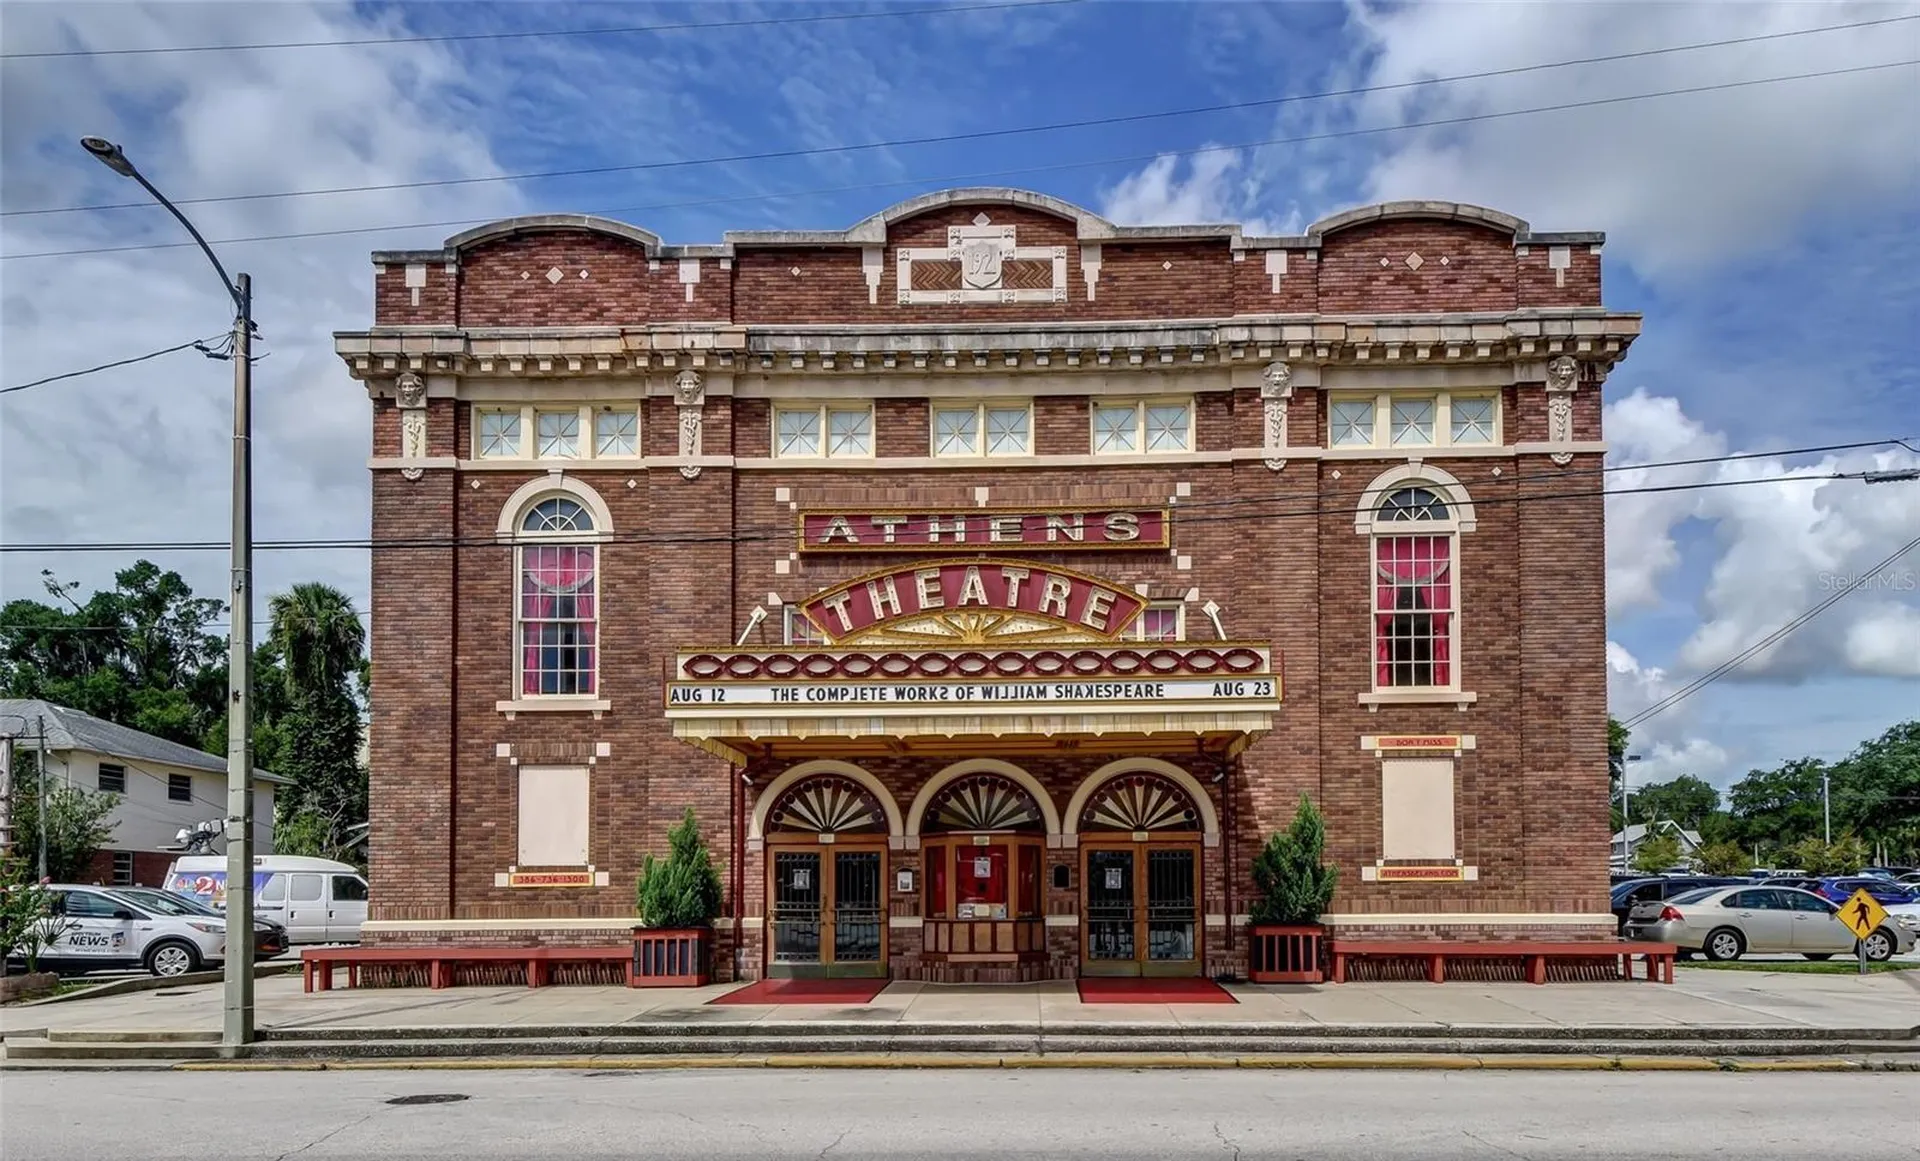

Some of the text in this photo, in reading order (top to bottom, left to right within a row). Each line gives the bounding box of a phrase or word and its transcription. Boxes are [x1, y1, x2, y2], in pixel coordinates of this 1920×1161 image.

[819, 512, 1140, 543] ATHENS
[823, 565, 1118, 632] THEATRE
[671, 681, 1272, 702] AUG 12 THE COMPLETE WORKS OF WILLIAM SHAKESPEARE AUG 23
[68, 936, 109, 946] NEWS
